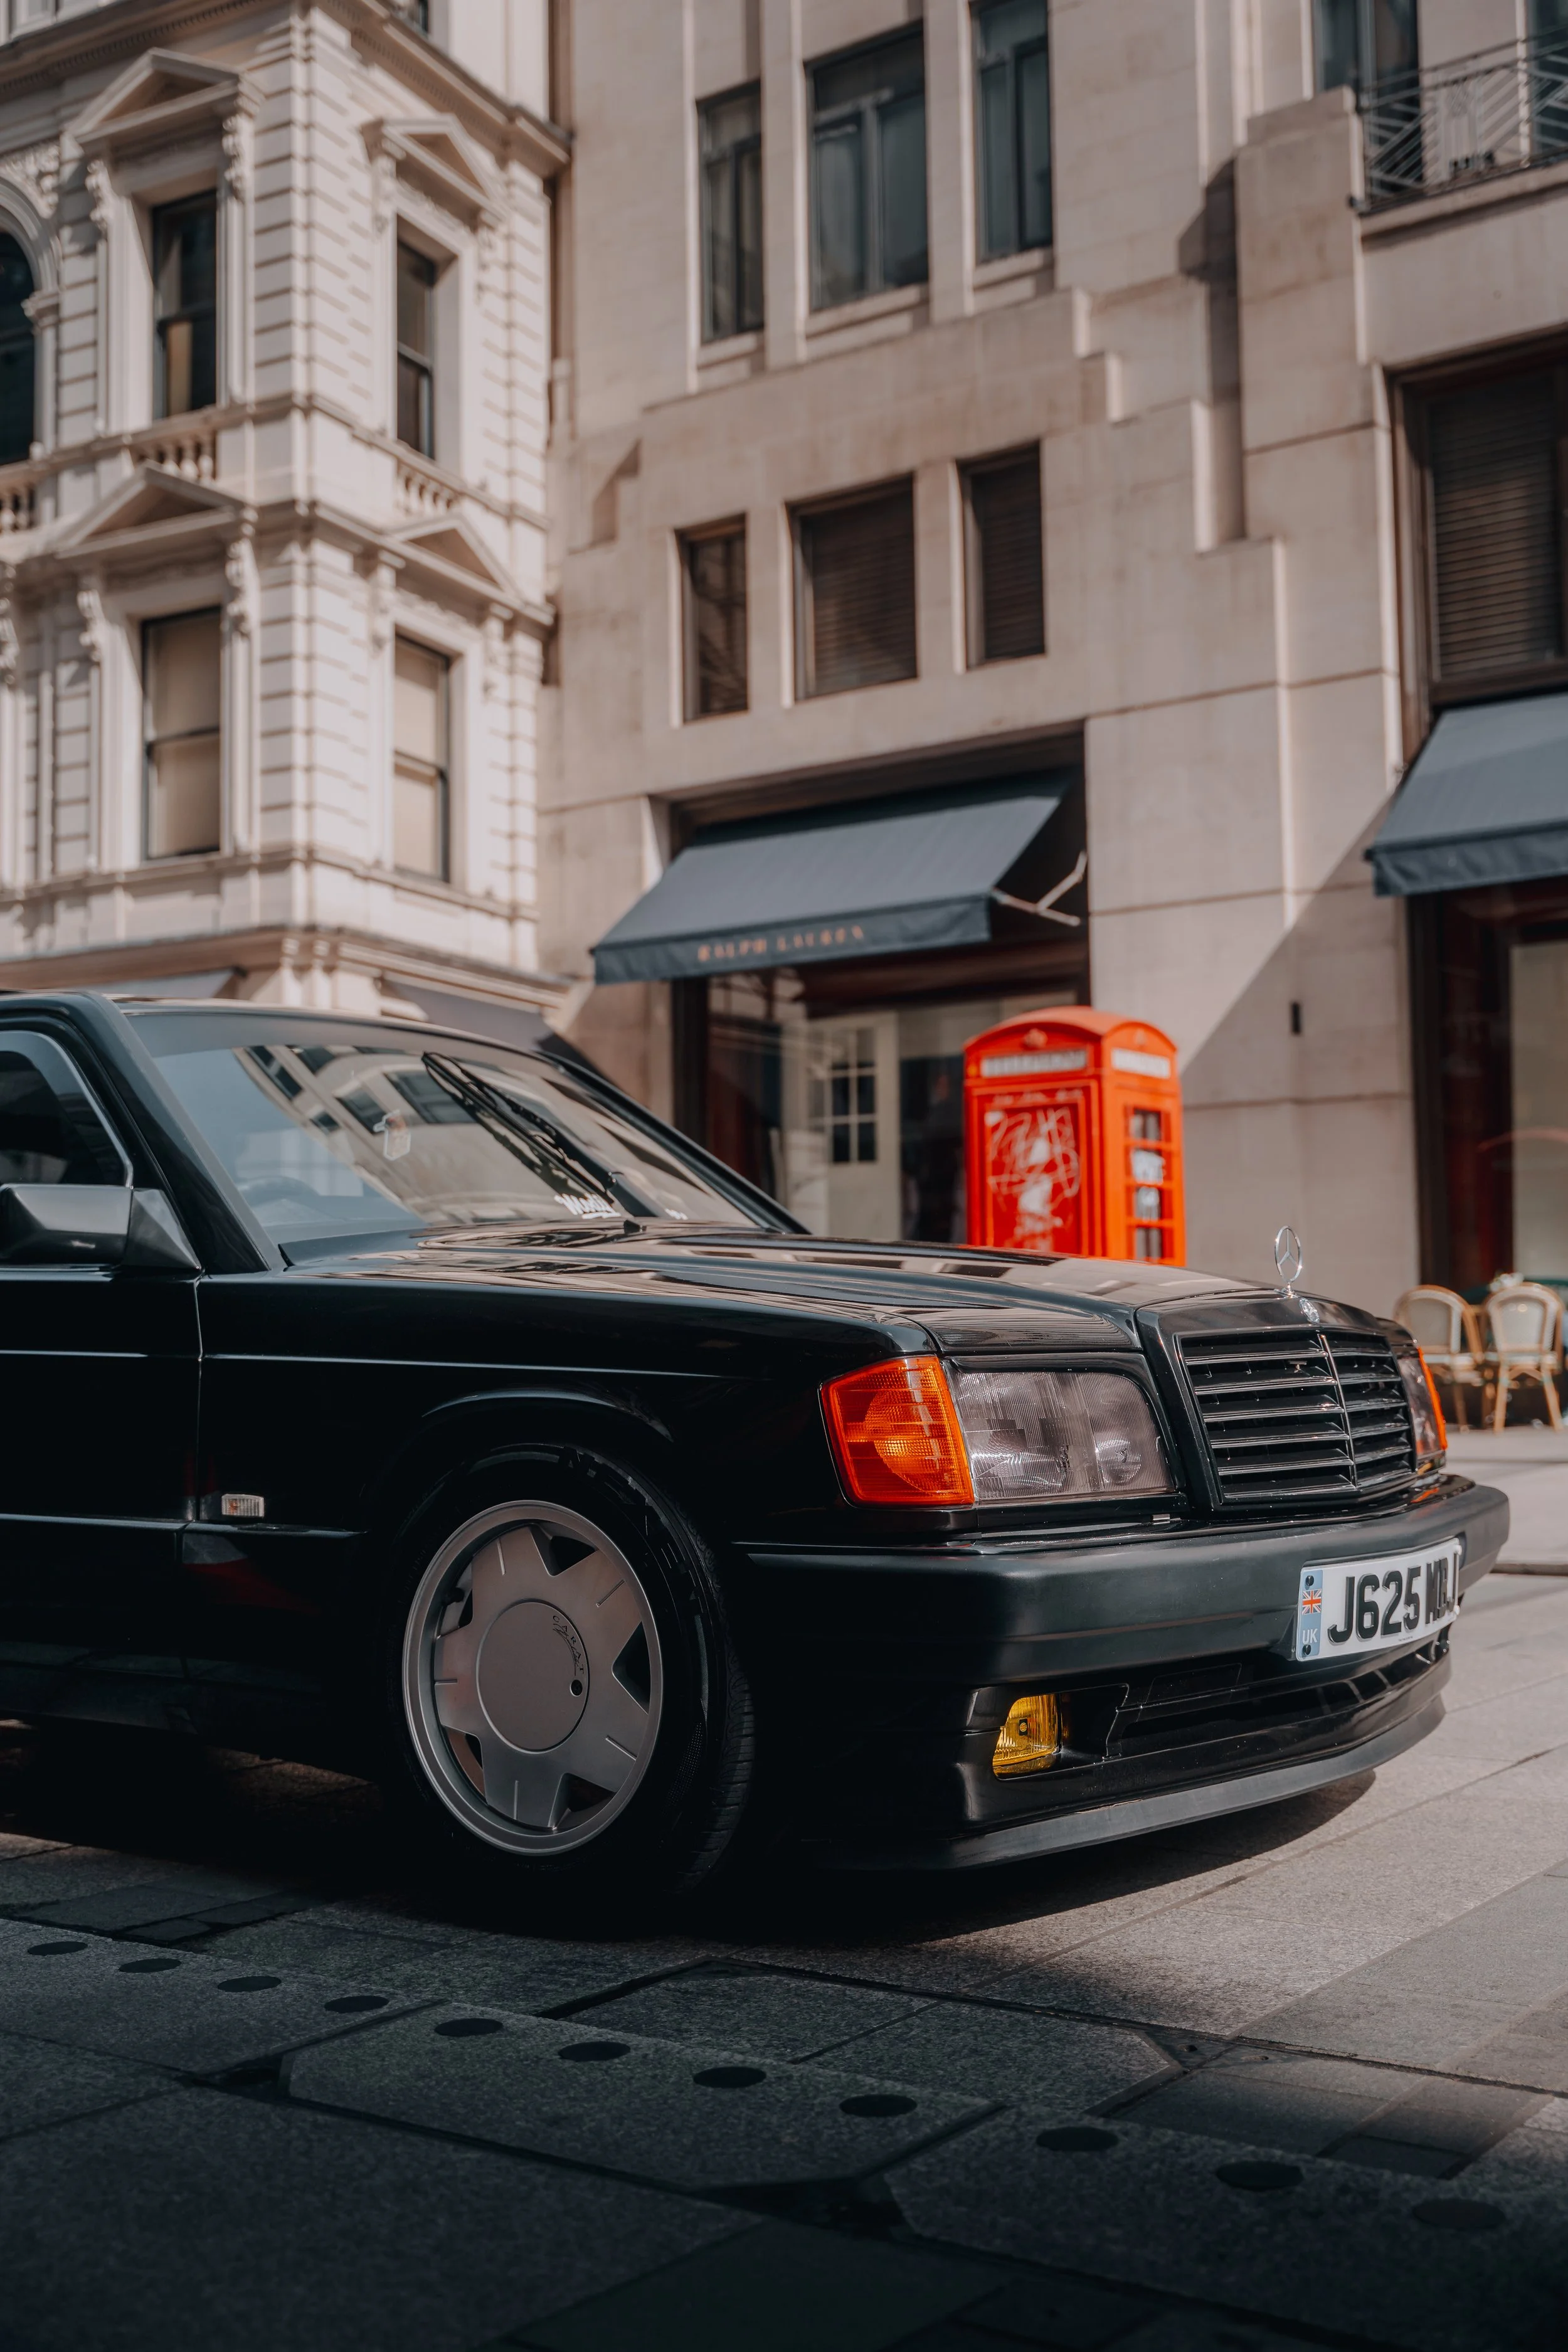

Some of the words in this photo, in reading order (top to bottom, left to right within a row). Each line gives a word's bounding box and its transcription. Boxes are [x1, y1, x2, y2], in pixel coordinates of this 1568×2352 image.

[697, 938, 768, 963] RALPH
[776, 924, 864, 953] LAUREN
[1327, 1565, 1422, 1643] J625
[552, 1614, 585, 1675] CARAT
[1302, 1628, 1318, 1644] UK
